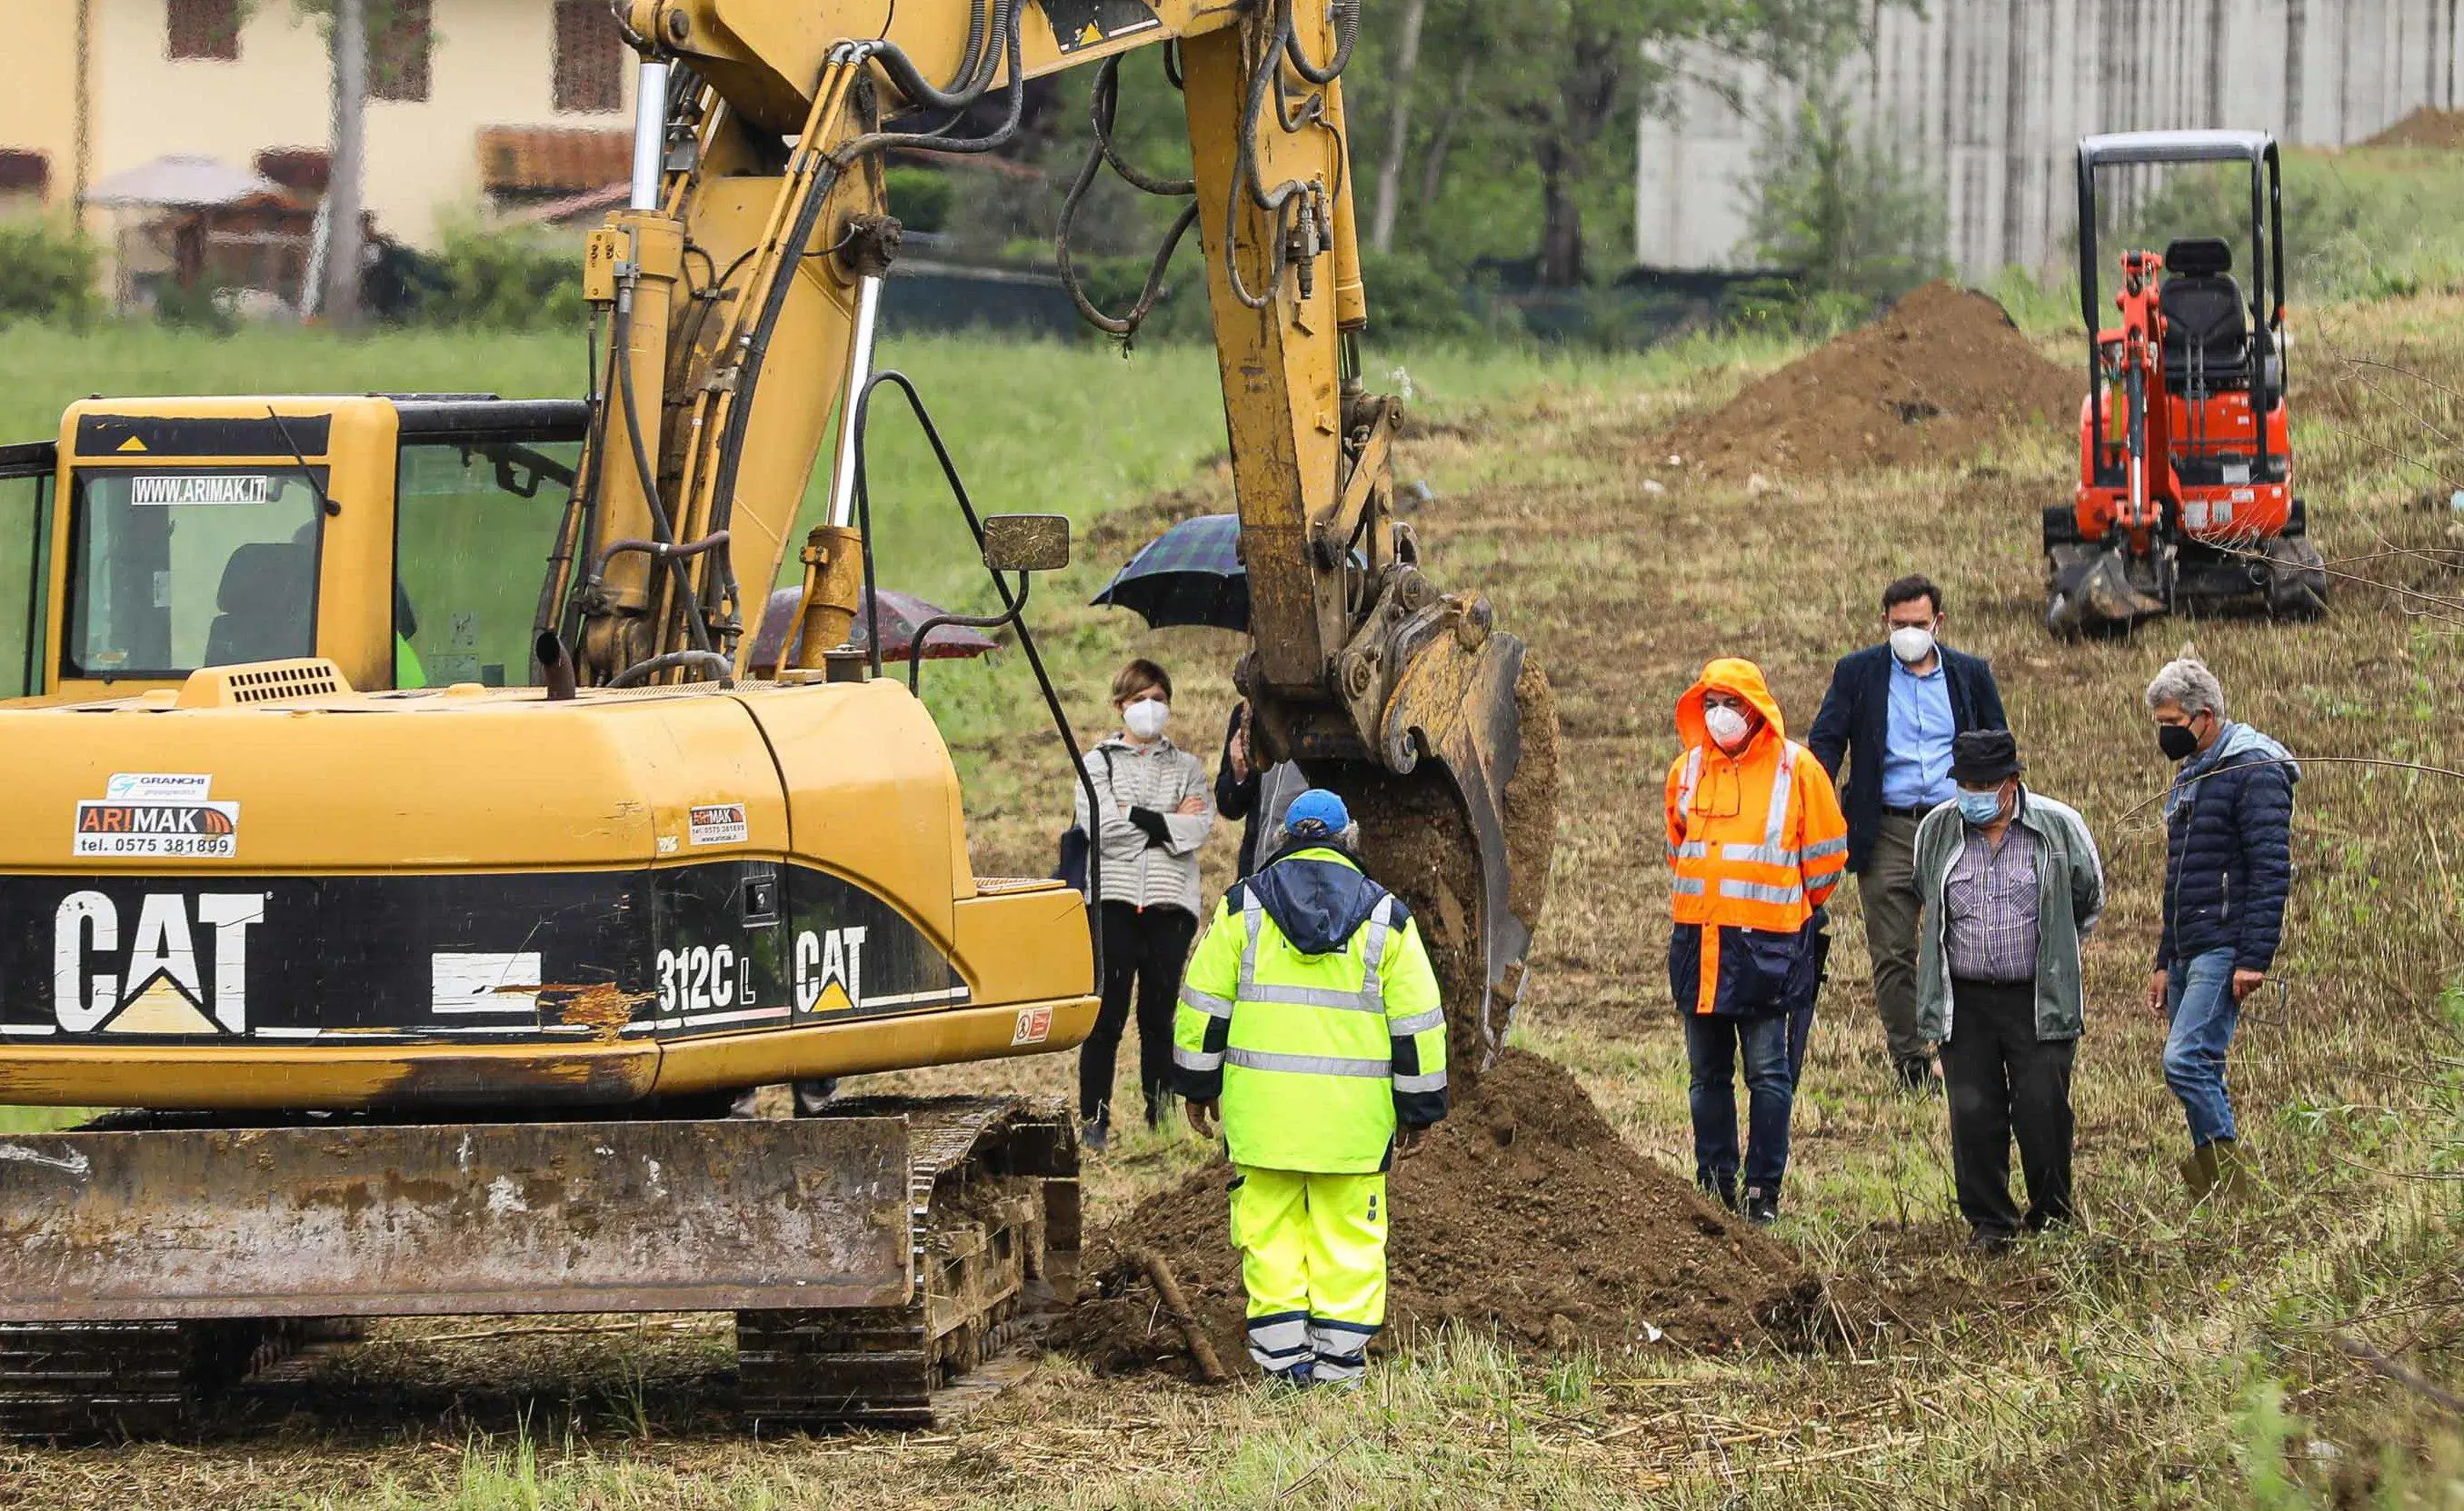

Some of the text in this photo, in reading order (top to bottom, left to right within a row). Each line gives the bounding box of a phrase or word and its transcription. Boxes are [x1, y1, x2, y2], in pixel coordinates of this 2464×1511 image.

[136, 478, 265, 502] WWW.ARIMAK.IT
[140, 777, 205, 785] GRANCHI
[80, 808, 200, 832] ARIMAK
[693, 809, 733, 824] ARIMAK
[81, 838, 229, 852] tel. 0575 381899
[55, 890, 264, 1034] CAT
[795, 926, 866, 1013] CAT
[656, 944, 756, 1012] 312C L
